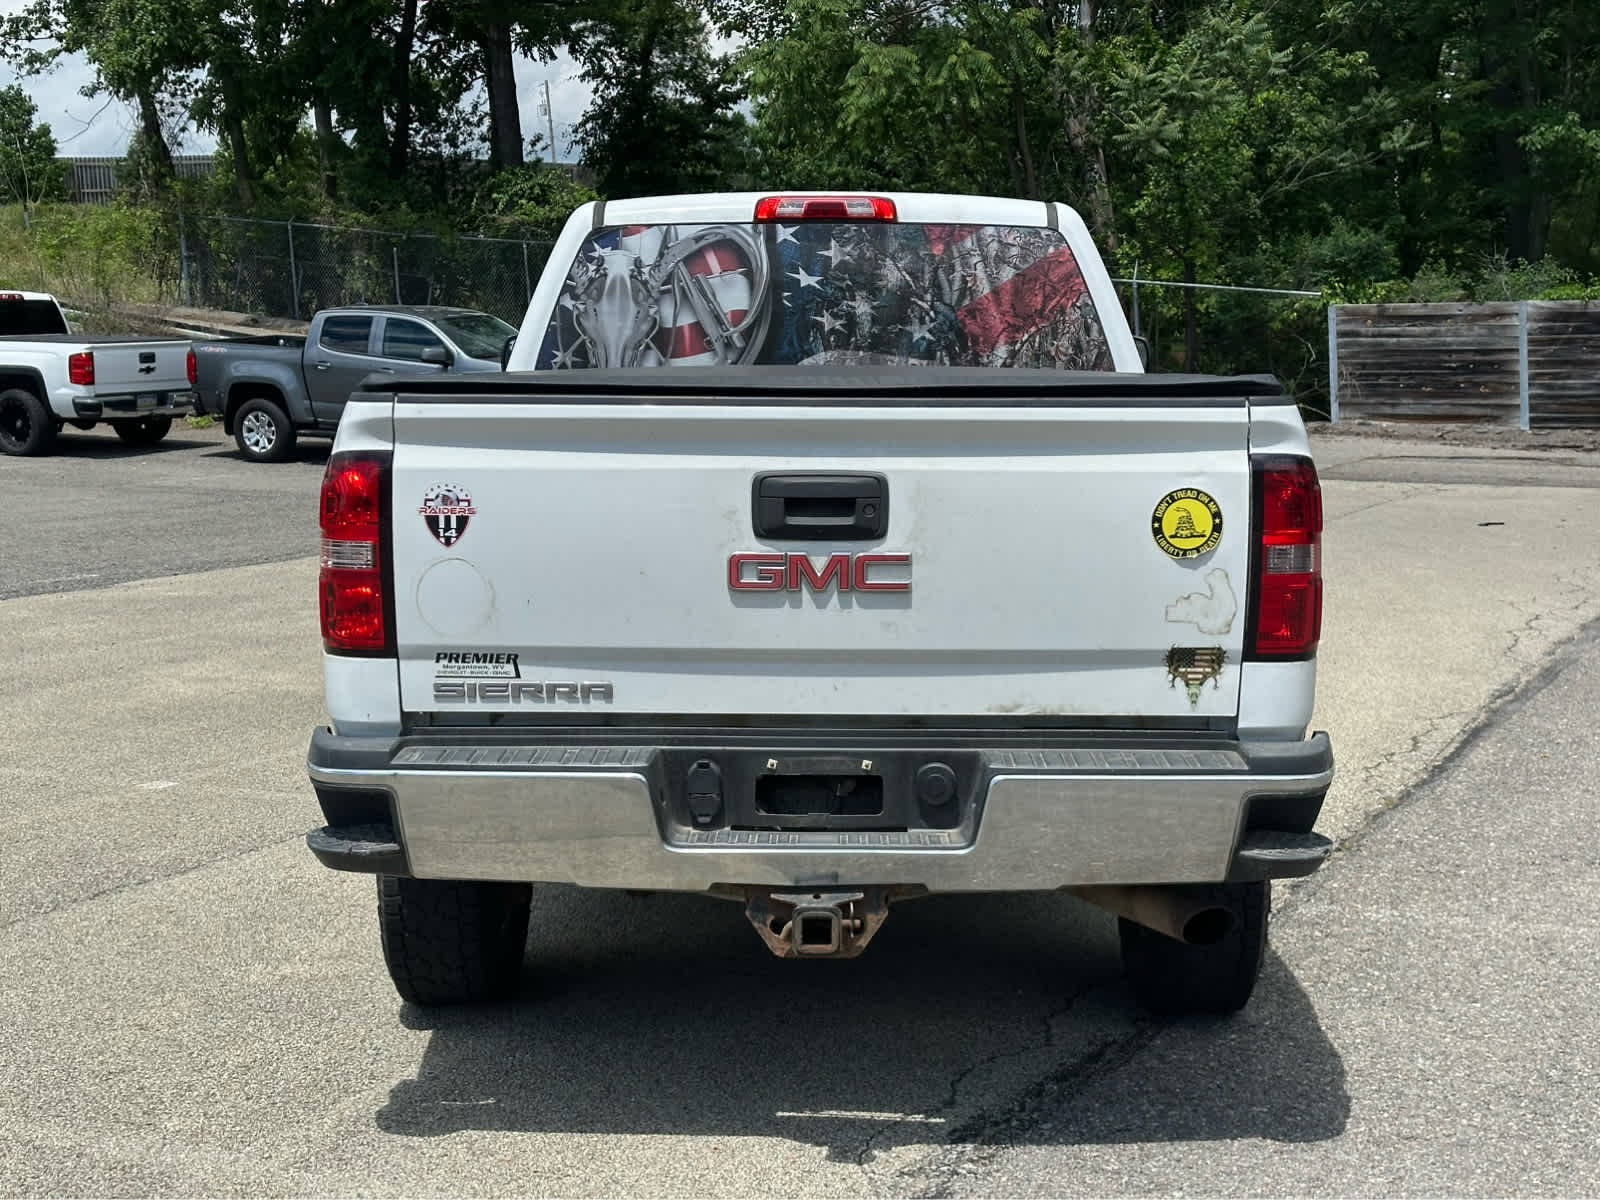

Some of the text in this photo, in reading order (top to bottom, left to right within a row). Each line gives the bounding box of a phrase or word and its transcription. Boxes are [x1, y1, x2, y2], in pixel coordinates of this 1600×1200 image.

[418, 507, 477, 515] RAIDERS
[1172, 490, 1198, 500] TREAD
[1198, 492, 1210, 504] ON
[1207, 502, 1219, 514] ME
[437, 528, 457, 537] 14
[1156, 534, 1184, 557] LIBERTY
[1199, 532, 1220, 553] DEATH
[728, 551, 913, 592] GMC
[434, 652, 520, 665] PREMIER
[433, 681, 613, 702] SIERRA
